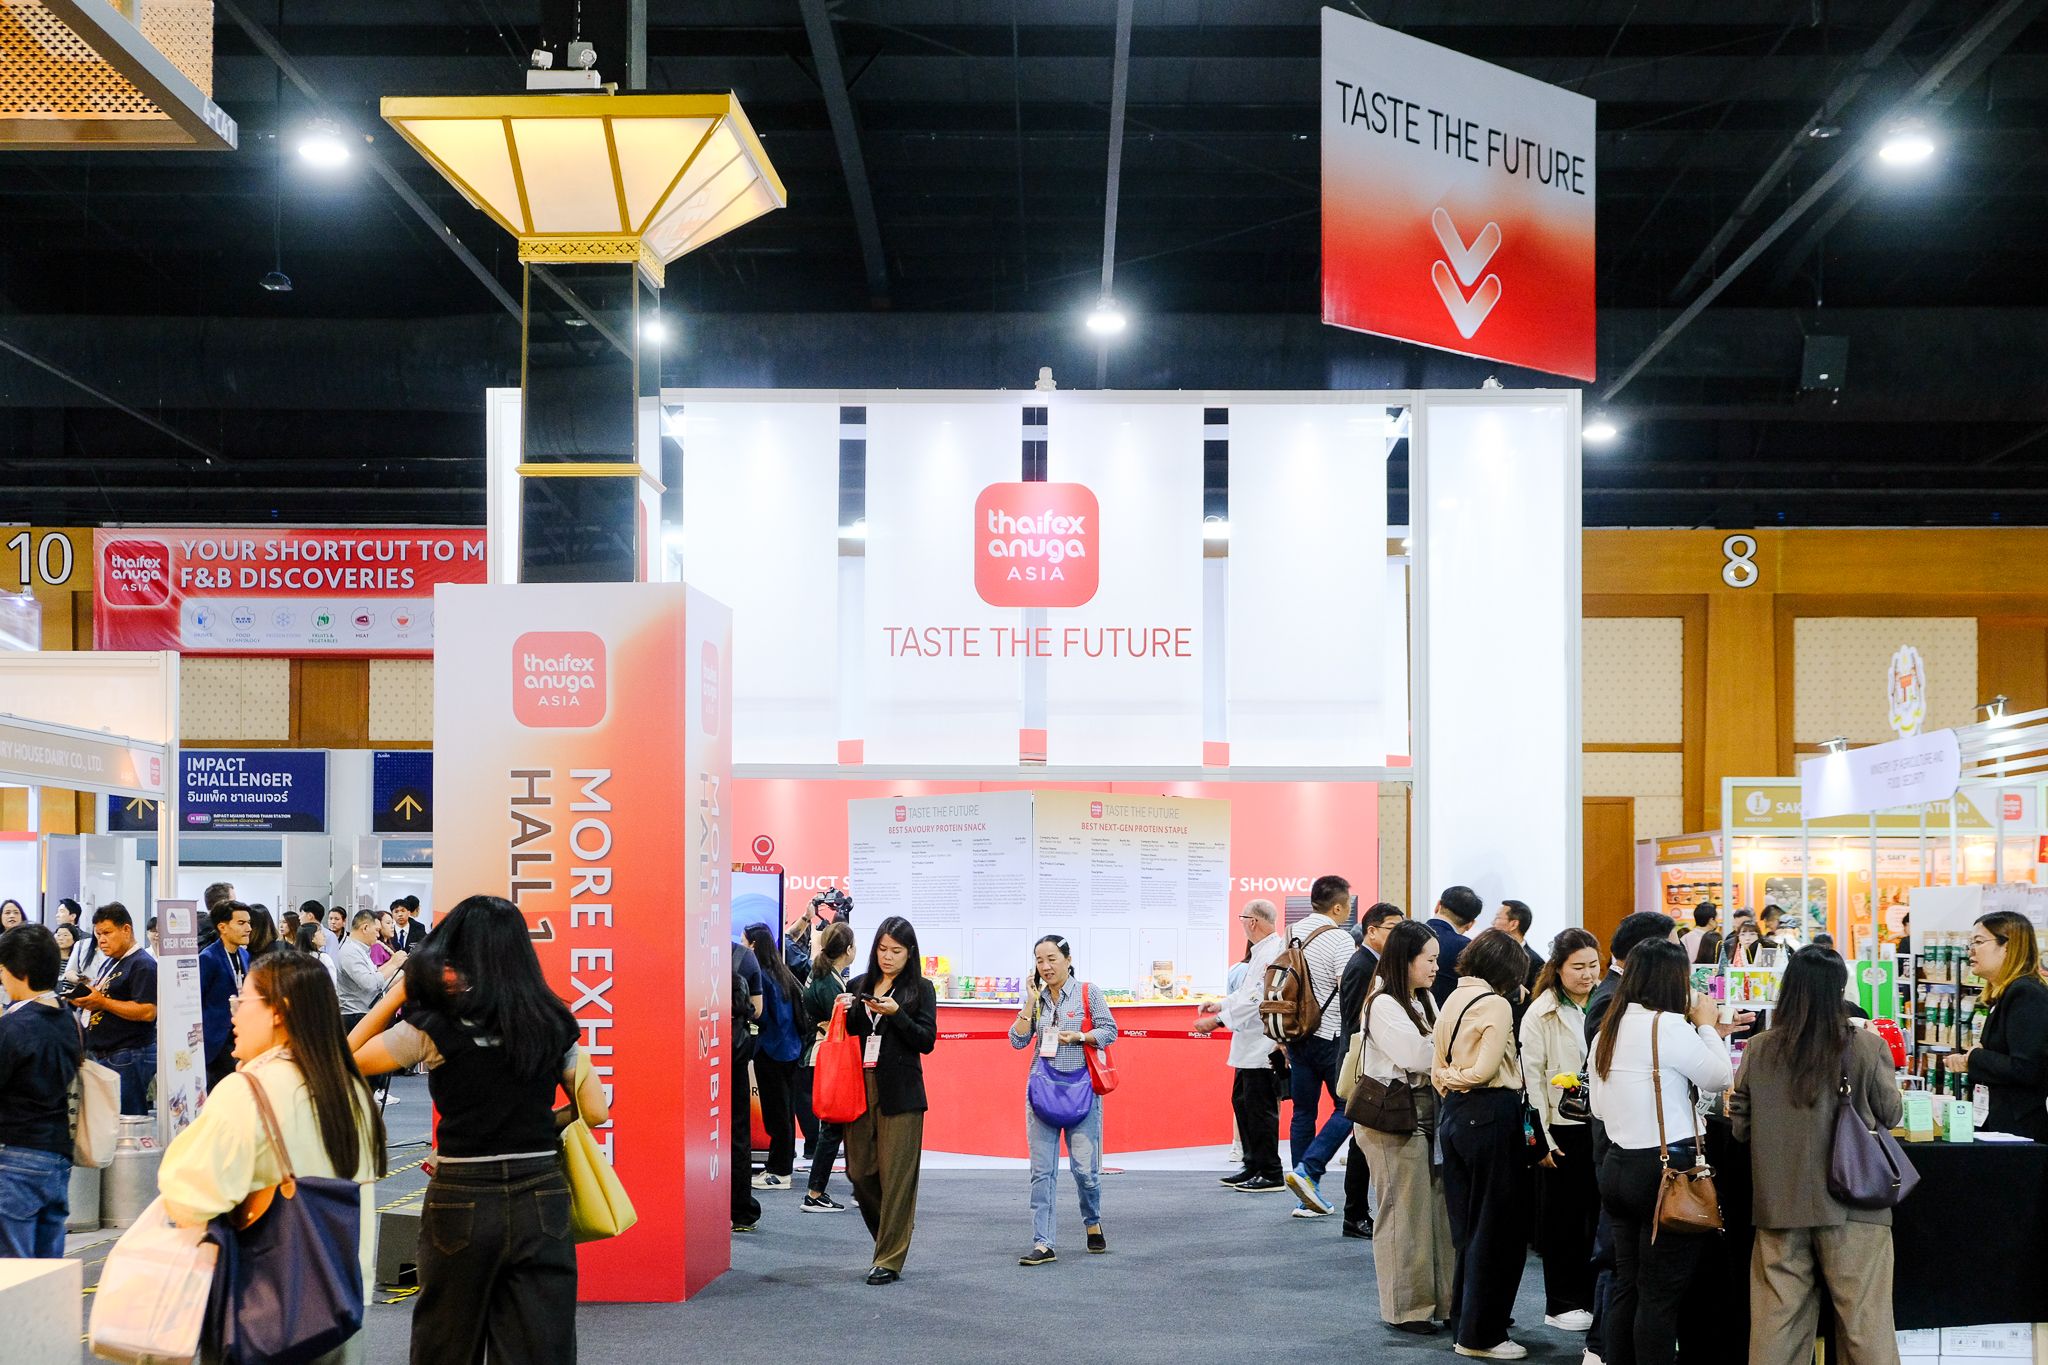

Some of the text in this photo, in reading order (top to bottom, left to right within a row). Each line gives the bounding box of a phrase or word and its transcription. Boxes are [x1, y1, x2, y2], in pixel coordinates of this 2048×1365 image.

[1335, 79, 1585, 195] TASTE THE FUTURE
[987, 509, 1086, 535] thaifex
[6, 531, 74, 586] 10
[180, 539, 484, 561] YOUR SHORTCUT TO M
[987, 538, 1086, 563] anuga
[111, 554, 161, 568] thaifex
[1721, 534, 1759, 588] 8
[111, 569, 161, 583] anuga
[180, 567, 415, 589] F&B DISCOVERIES
[1007, 566, 1065, 581] ASIA
[121, 584, 151, 592] ASIA
[883, 627, 1192, 657] TASTE THE FUTURE
[523, 653, 594, 672] thaifex
[524, 674, 595, 693] anuga
[537, 695, 580, 706] ASIA
[0, 741, 13, 758] RY
[14, 743, 44, 763] HOUSE
[45, 748, 69, 768] DAIRY
[187, 757, 245, 772] IMPACT
[187, 772, 293, 787] CHALLENGER
[909, 807, 931, 819] TASTE
[933, 806, 947, 817] THE
[949, 804, 980, 817] FUTURE
[1105, 805, 1128, 816] TASTE
[1130, 806, 1146, 817] THE
[1148, 807, 1180, 819] FUTURE
[510, 768, 552, 905] HALL
[699, 772, 709, 898] HALL
[888, 823, 987, 834] BEST SAVOURY PROTEIN SNACK
[1081, 822, 1188, 834] BEST NEXT-GEN PROTEIN STAPLE
[569, 768, 613, 928] MORE
[784, 876, 839, 890] DUCT
[1240, 877, 1318, 892] SHOWC
[709, 776, 721, 1181] MORE EXHIBITS
